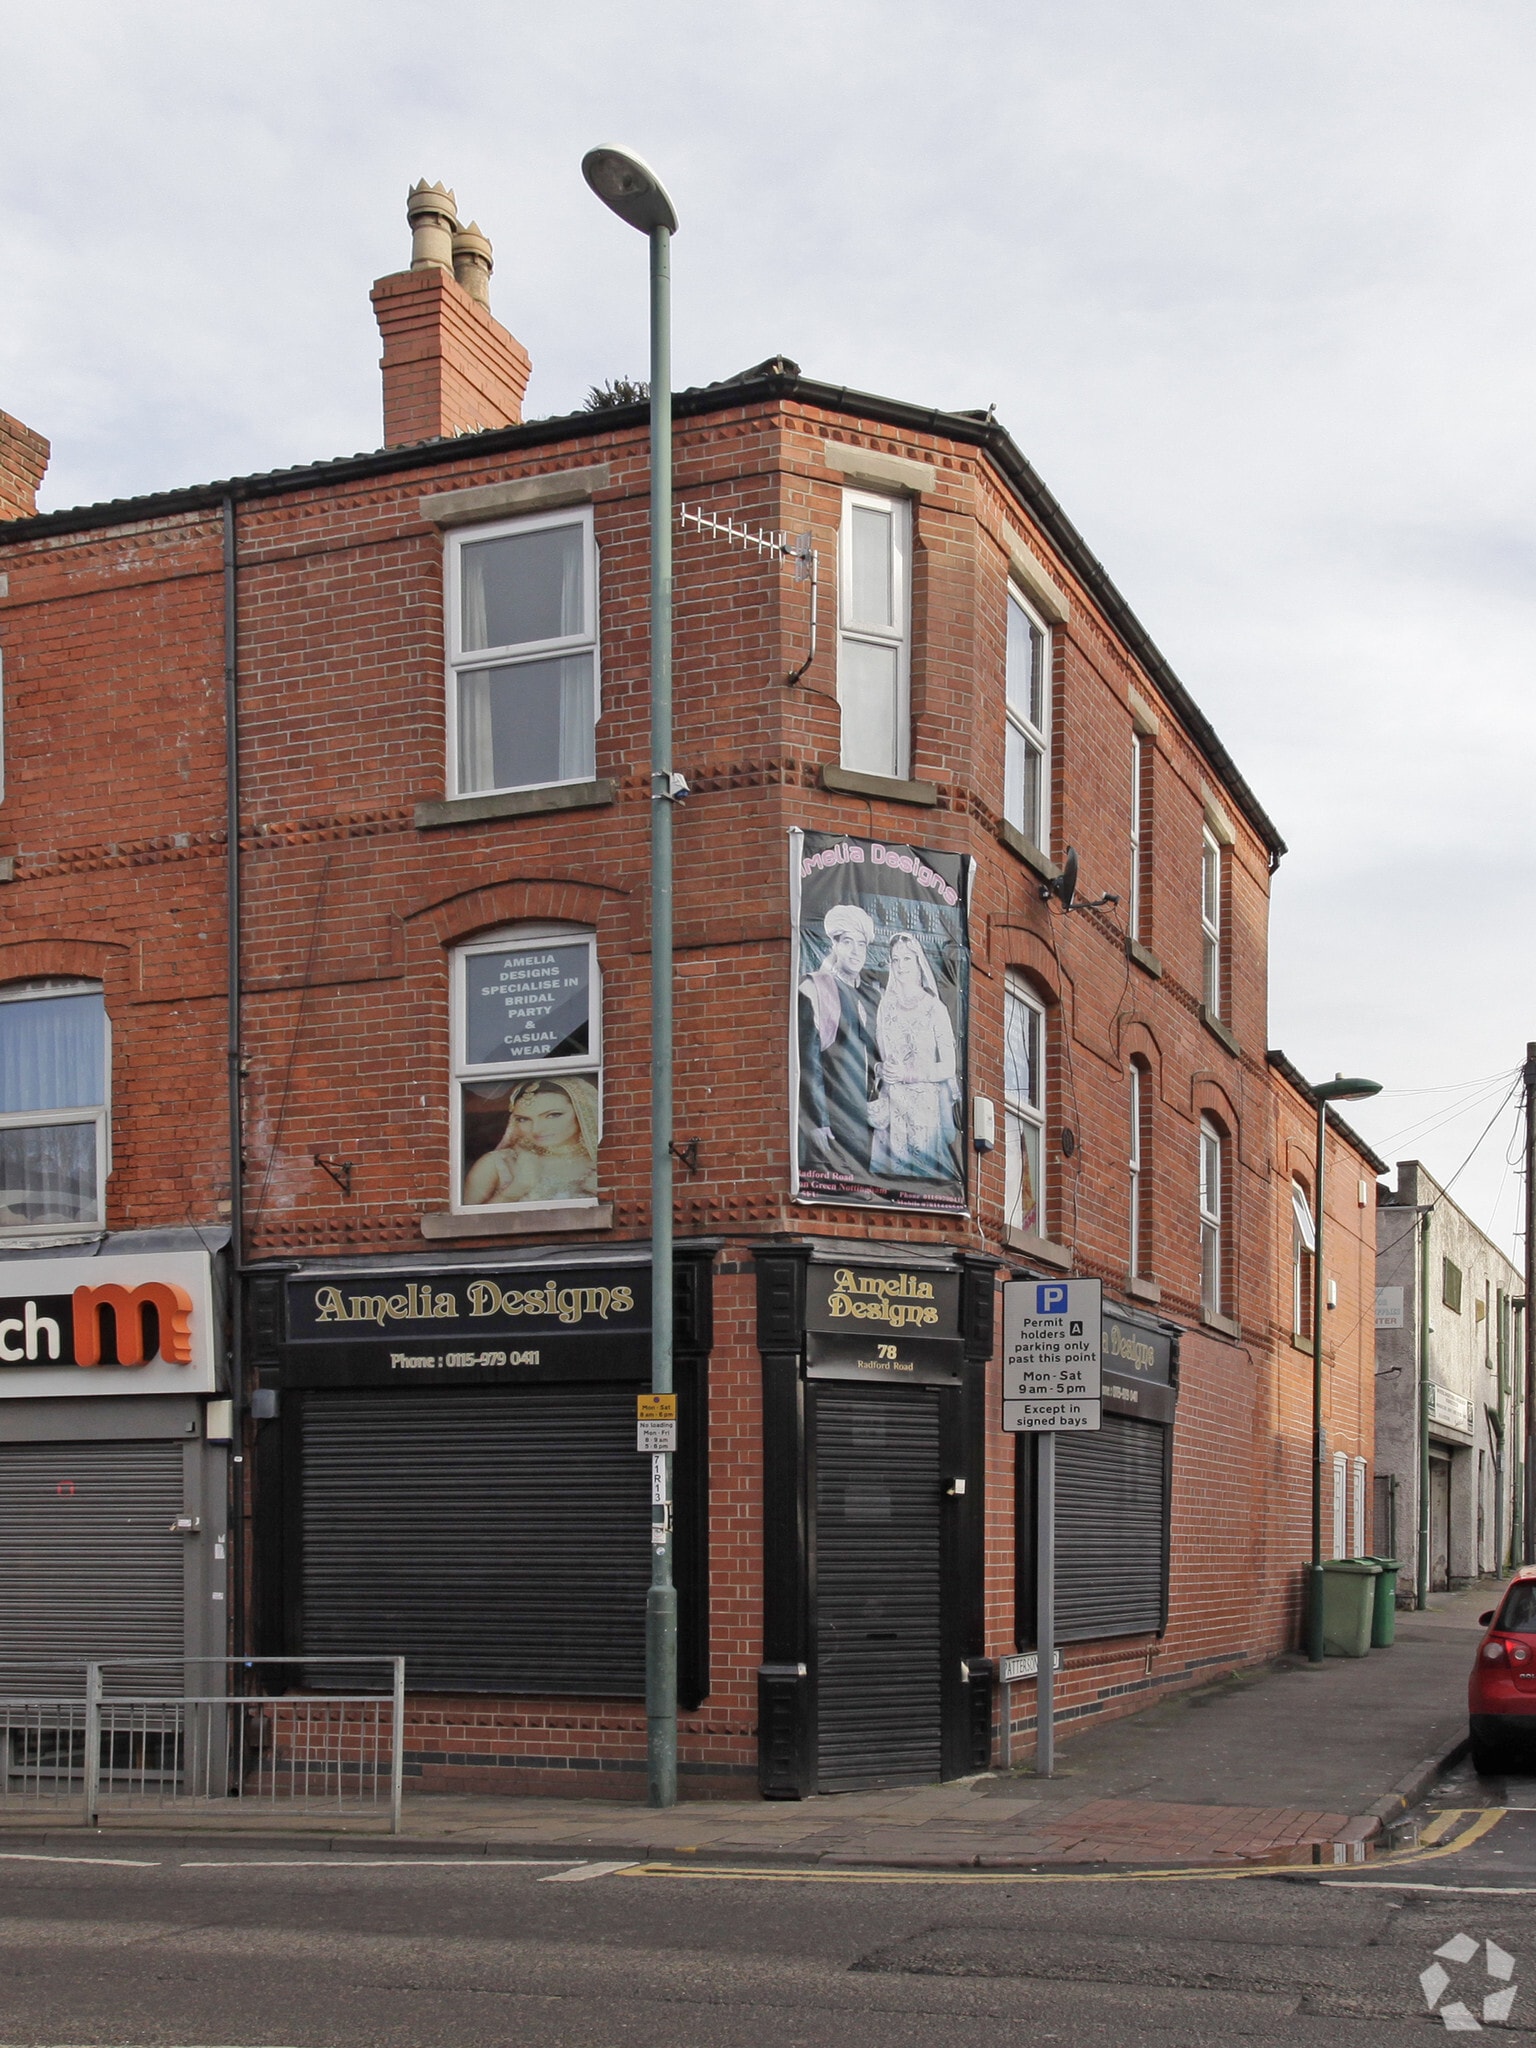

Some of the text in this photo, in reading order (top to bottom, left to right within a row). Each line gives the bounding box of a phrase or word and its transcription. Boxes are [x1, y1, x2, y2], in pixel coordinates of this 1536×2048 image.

[871, 843, 959, 906] Designs
[504, 955, 556, 969] AMELIA
[500, 967, 560, 982] DESIGNS
[481, 977, 579, 996] SPECIALISE IN
[505, 993, 556, 1007] BRIDAL
[508, 1006, 553, 1019] PARTY
[525, 1020, 536, 1030] &
[504, 1031, 558, 1045] CASUAL
[510, 1044, 552, 1057] WEAR
[832, 1172, 854, 1181] Road
[811, 1181, 837, 1191] Green
[834, 1268, 935, 1299] Amelia
[315, 1280, 634, 1327] Amelia Designs
[1044, 1288, 1064, 1312] P
[828, 1293, 939, 1328] Designs
[1023, 1318, 1064, 1328] Permit
[1071, 1323, 1081, 1335] A
[1021, 1329, 1065, 1340] holders
[877, 1344, 897, 1360] 78
[1015, 1342, 1060, 1354] parking
[1064, 1341, 1090, 1351] only
[1110, 1325, 1155, 1371] Designs
[390, 1353, 435, 1369] Phone
[445, 1351, 507, 1368] 0115-979
[509, 1350, 540, 1366] 0411
[1008, 1352, 1097, 1365] past this point
[857, 1360, 914, 1372] Radford Road
[1023, 1371, 1050, 1381] Mon
[1059, 1370, 1082, 1381] Sat
[1024, 1403, 1081, 1416] Except in
[1016, 1415, 1088, 1427] signed bays
